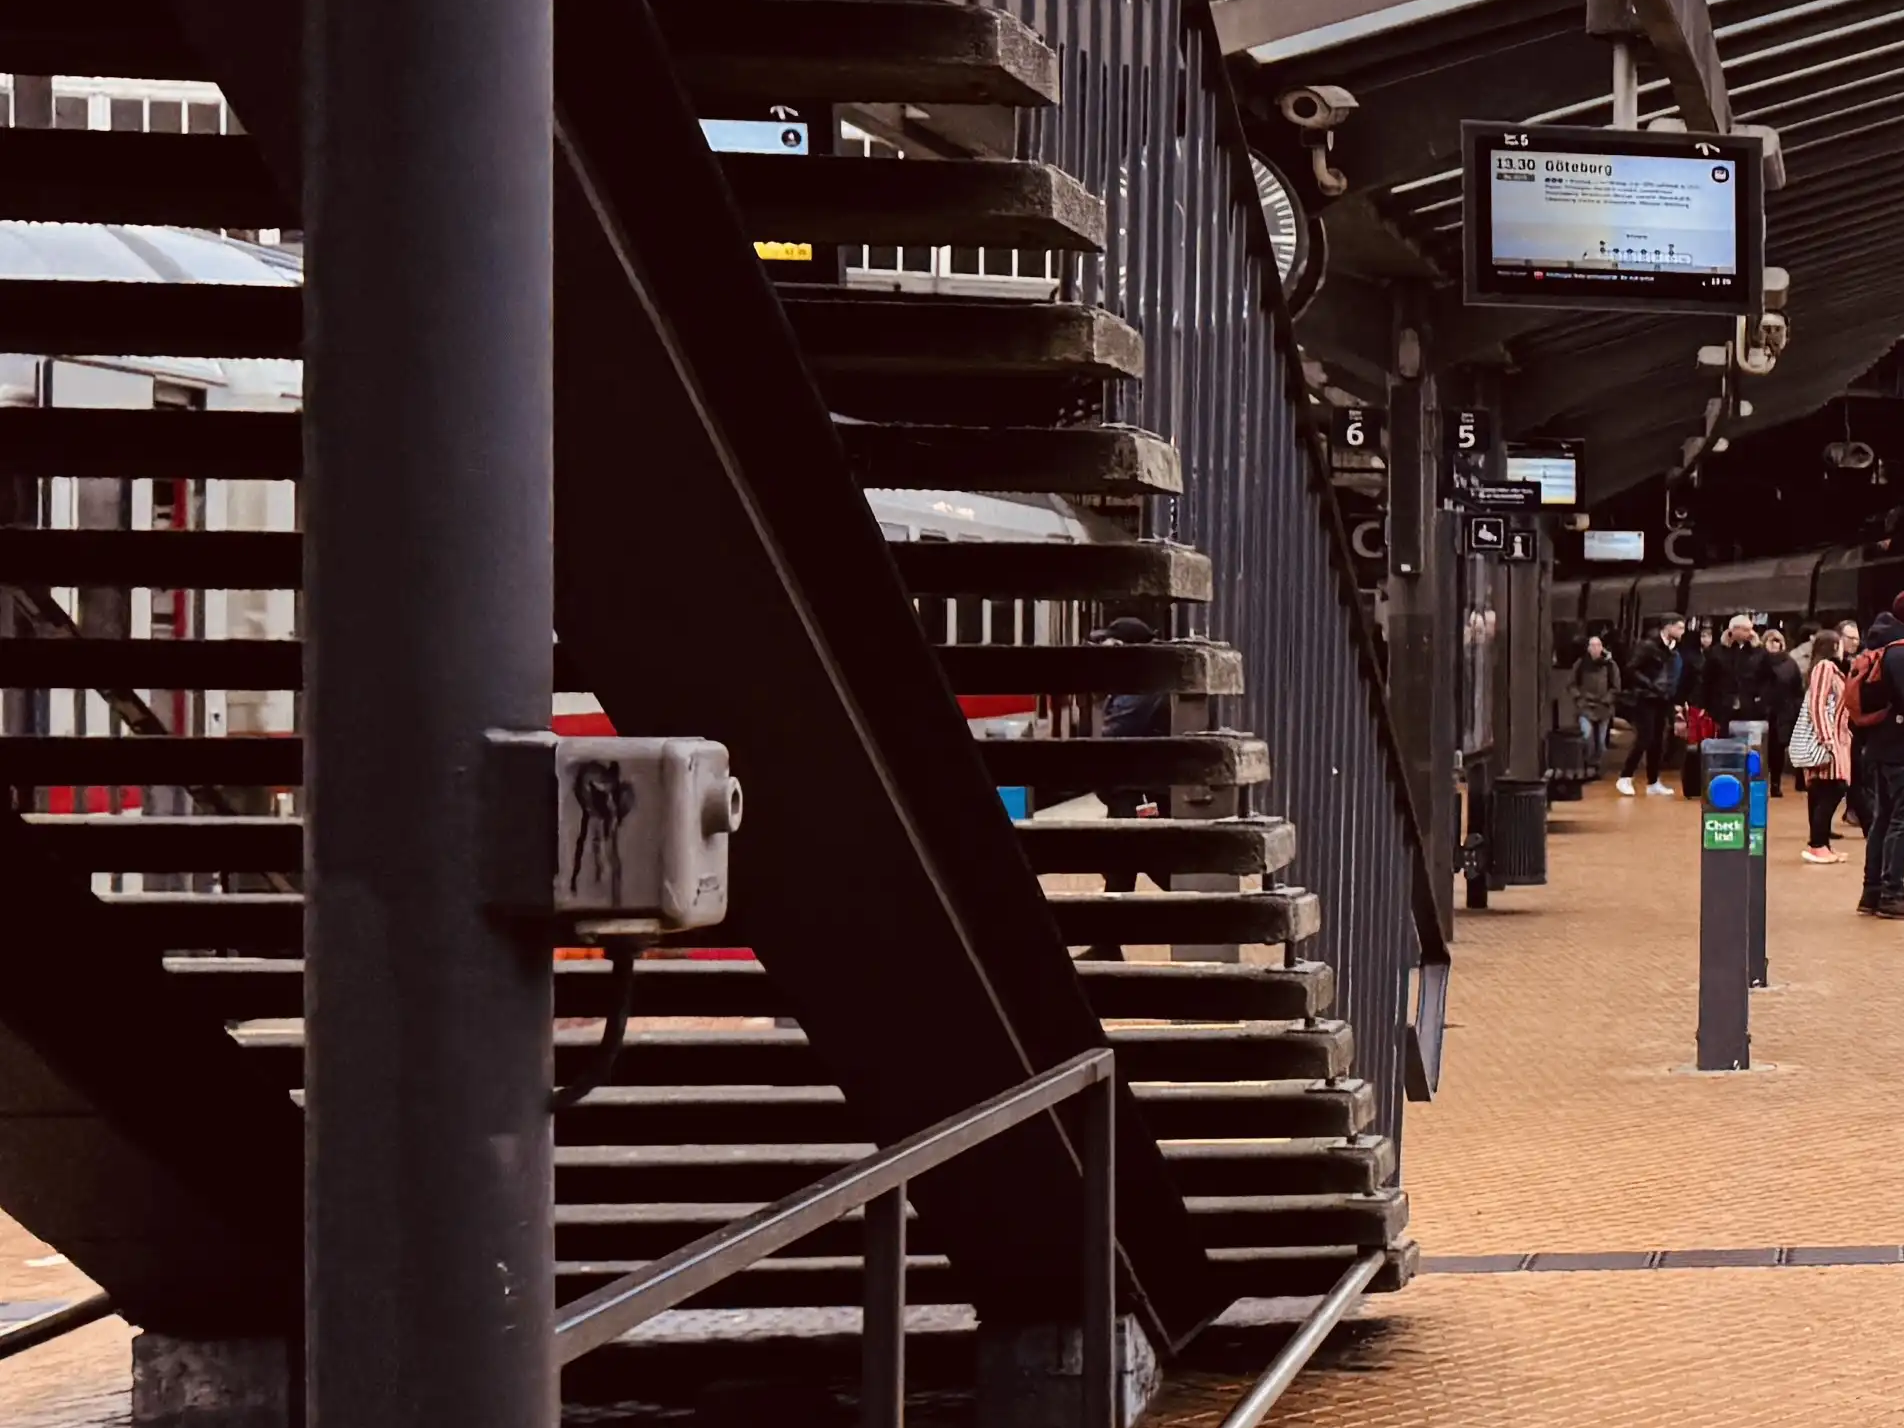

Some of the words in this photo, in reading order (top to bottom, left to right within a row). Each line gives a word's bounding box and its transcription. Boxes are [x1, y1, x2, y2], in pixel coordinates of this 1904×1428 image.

[1544, 158, 1613, 176] Göteborg
[1346, 422, 1364, 446] 6
[1458, 424, 1476, 448] 5
[1351, 521, 1383, 559] C
[1664, 528, 1694, 565] C
[1705, 819, 1741, 832] Check
